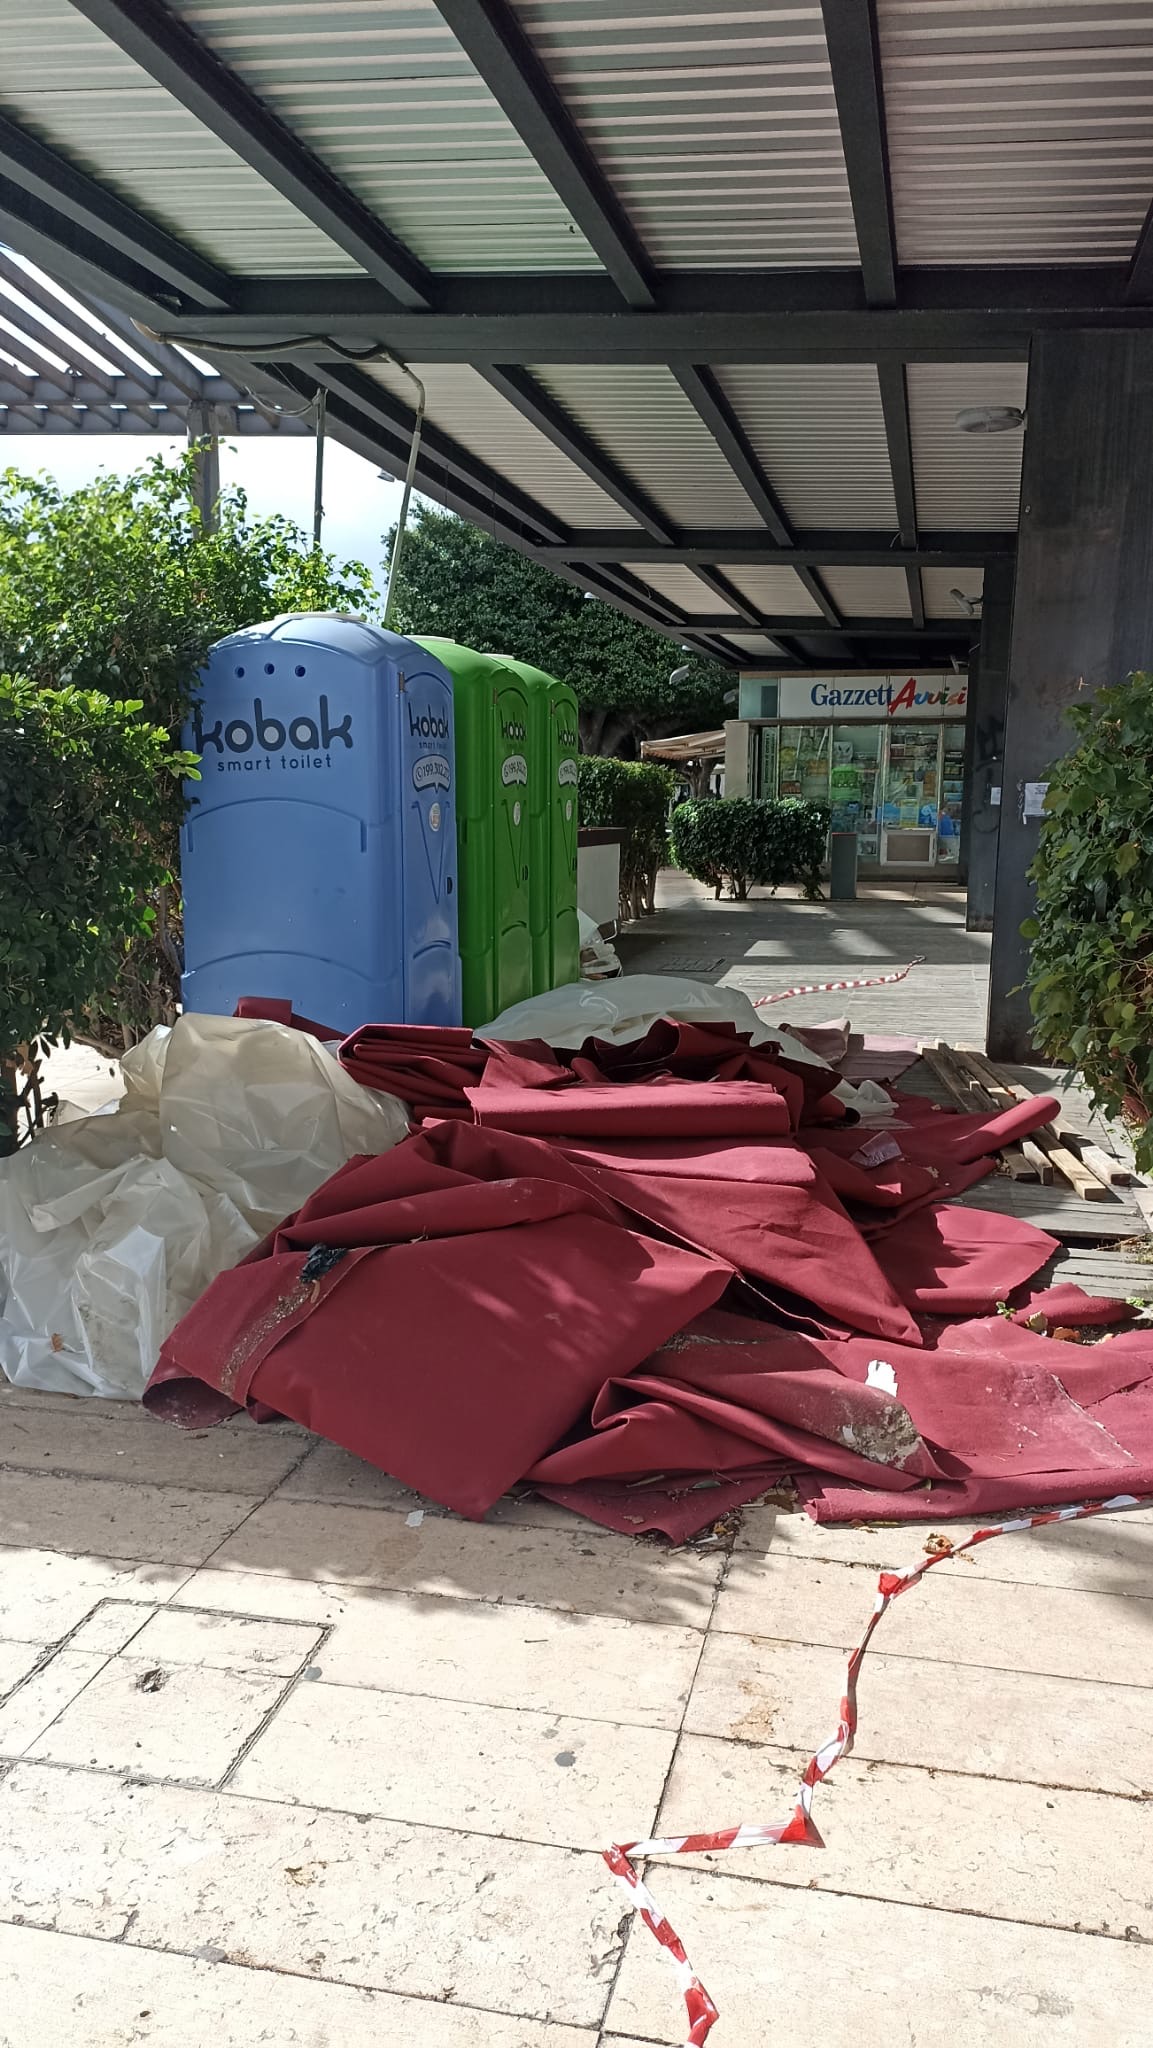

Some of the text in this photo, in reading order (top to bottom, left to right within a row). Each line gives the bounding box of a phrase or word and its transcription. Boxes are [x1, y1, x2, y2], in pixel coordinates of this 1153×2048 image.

[194, 695, 353, 753] kobak
[408, 702, 449, 739] kobak
[217, 753, 332, 772] smart toilet
